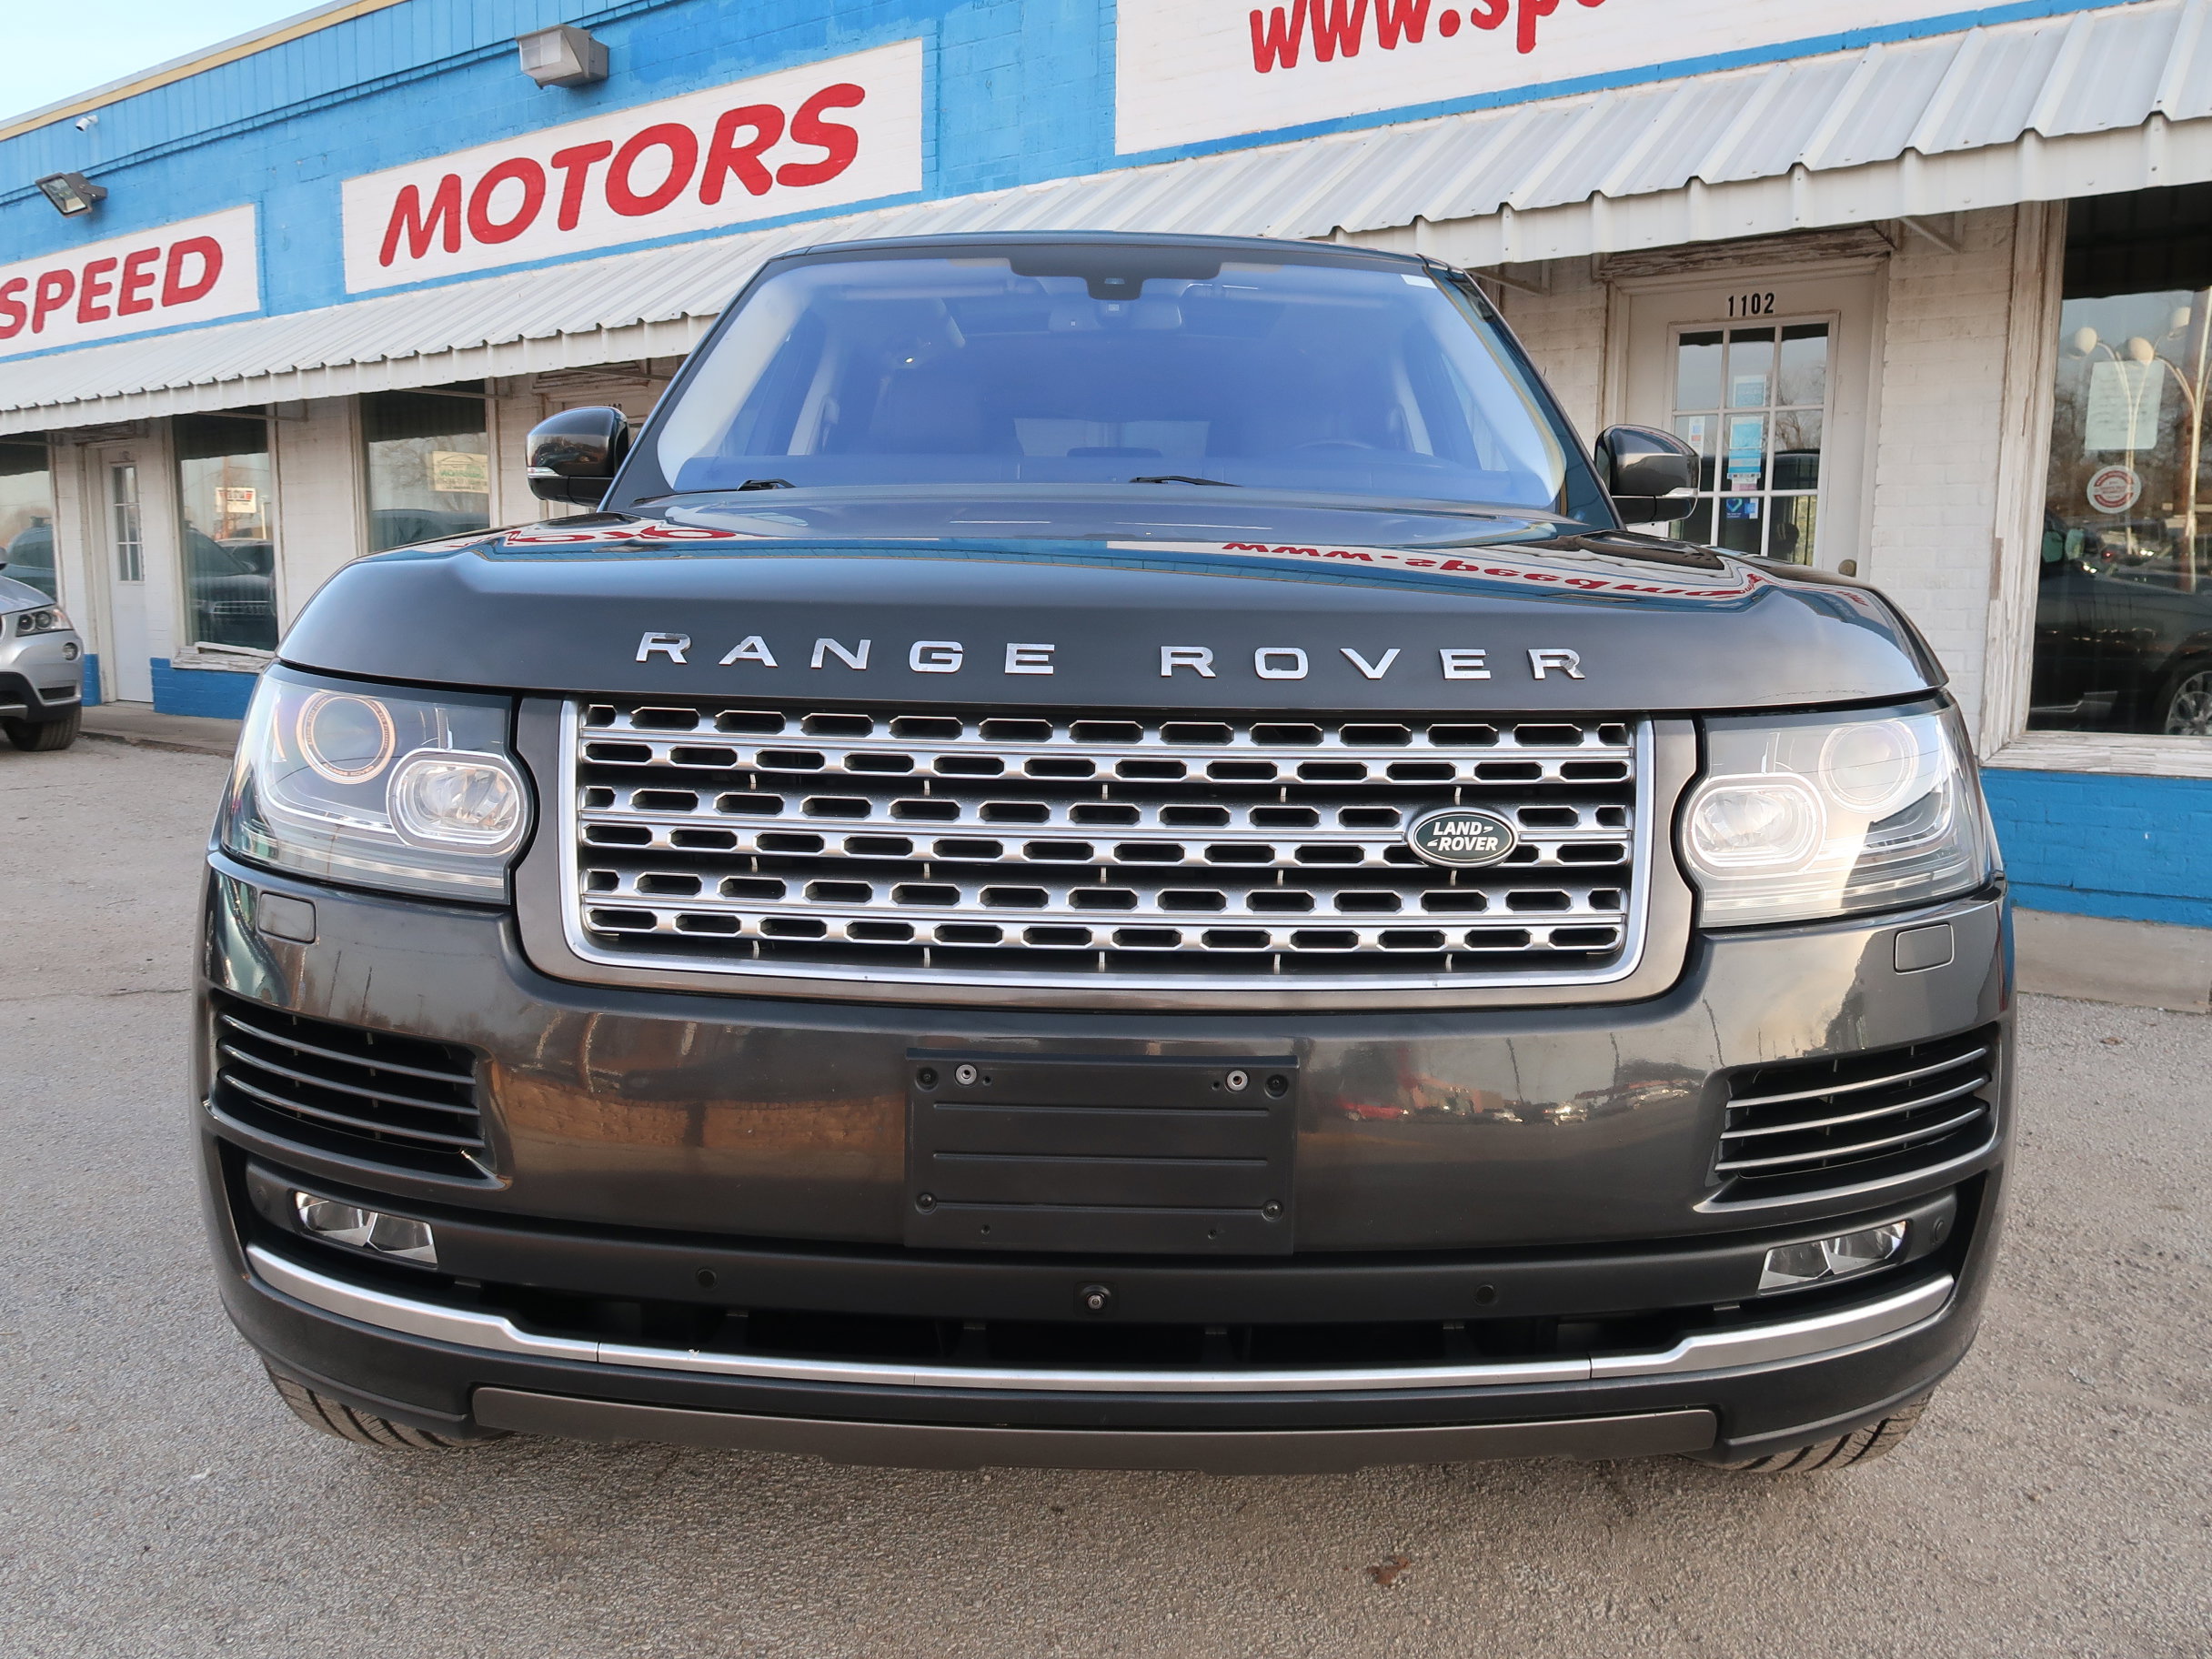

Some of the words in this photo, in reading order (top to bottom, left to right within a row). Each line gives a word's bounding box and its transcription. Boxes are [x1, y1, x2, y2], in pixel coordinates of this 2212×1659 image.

[0, 236, 223, 339] SPEED
[379, 83, 865, 266] MOTORS
[1728, 293, 1775, 317] 1102
[636, 631, 1055, 675] RANGE
[1160, 645, 1586, 680] ROVER
[1433, 821, 1483, 835] LAND
[1438, 836, 1498, 851] ROVER
